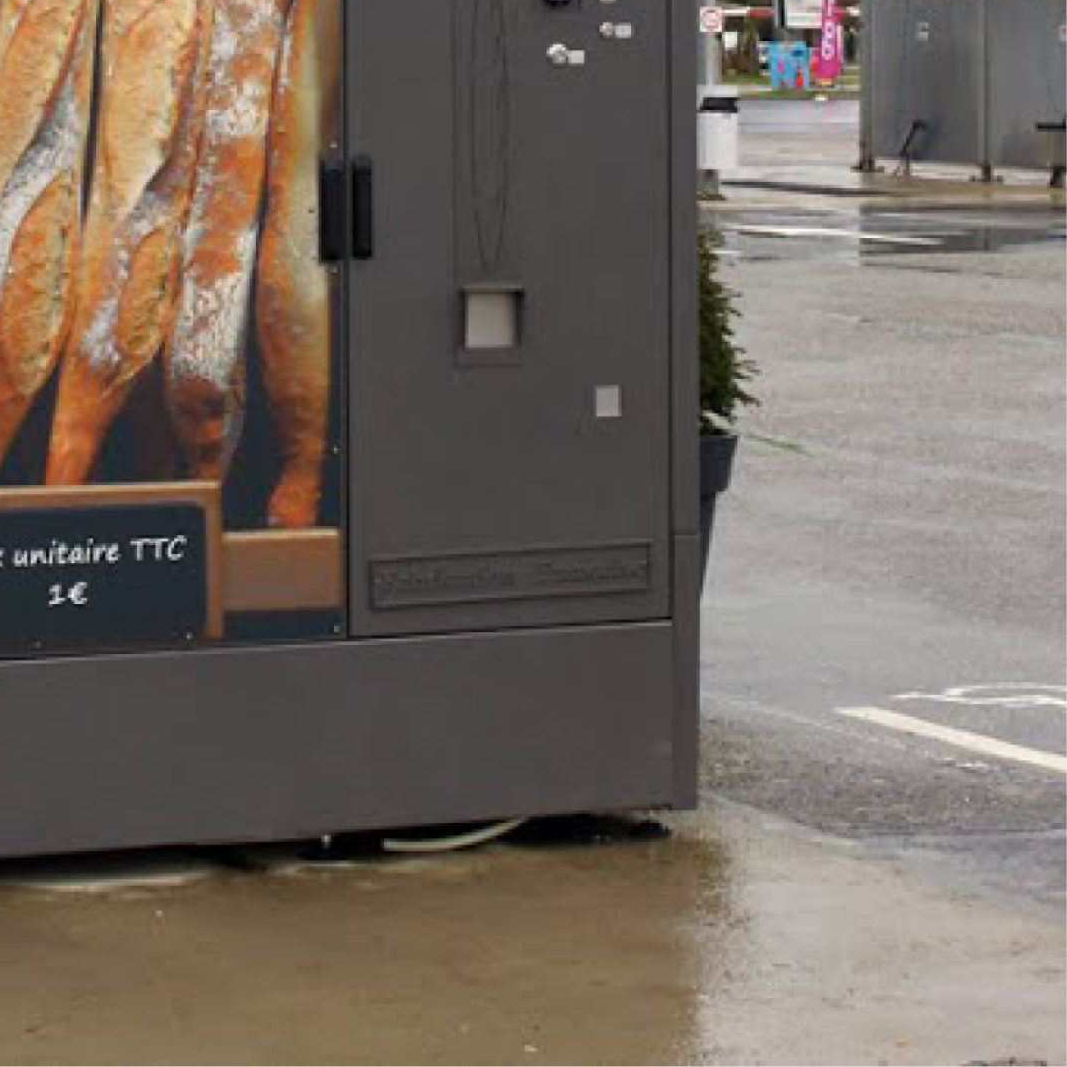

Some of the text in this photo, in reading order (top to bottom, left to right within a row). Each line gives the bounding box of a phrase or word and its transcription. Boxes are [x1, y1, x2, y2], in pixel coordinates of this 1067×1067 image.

[13, 537, 120, 567] unitaire
[130, 534, 187, 561] TTC
[48, 582, 88, 606] 1€
